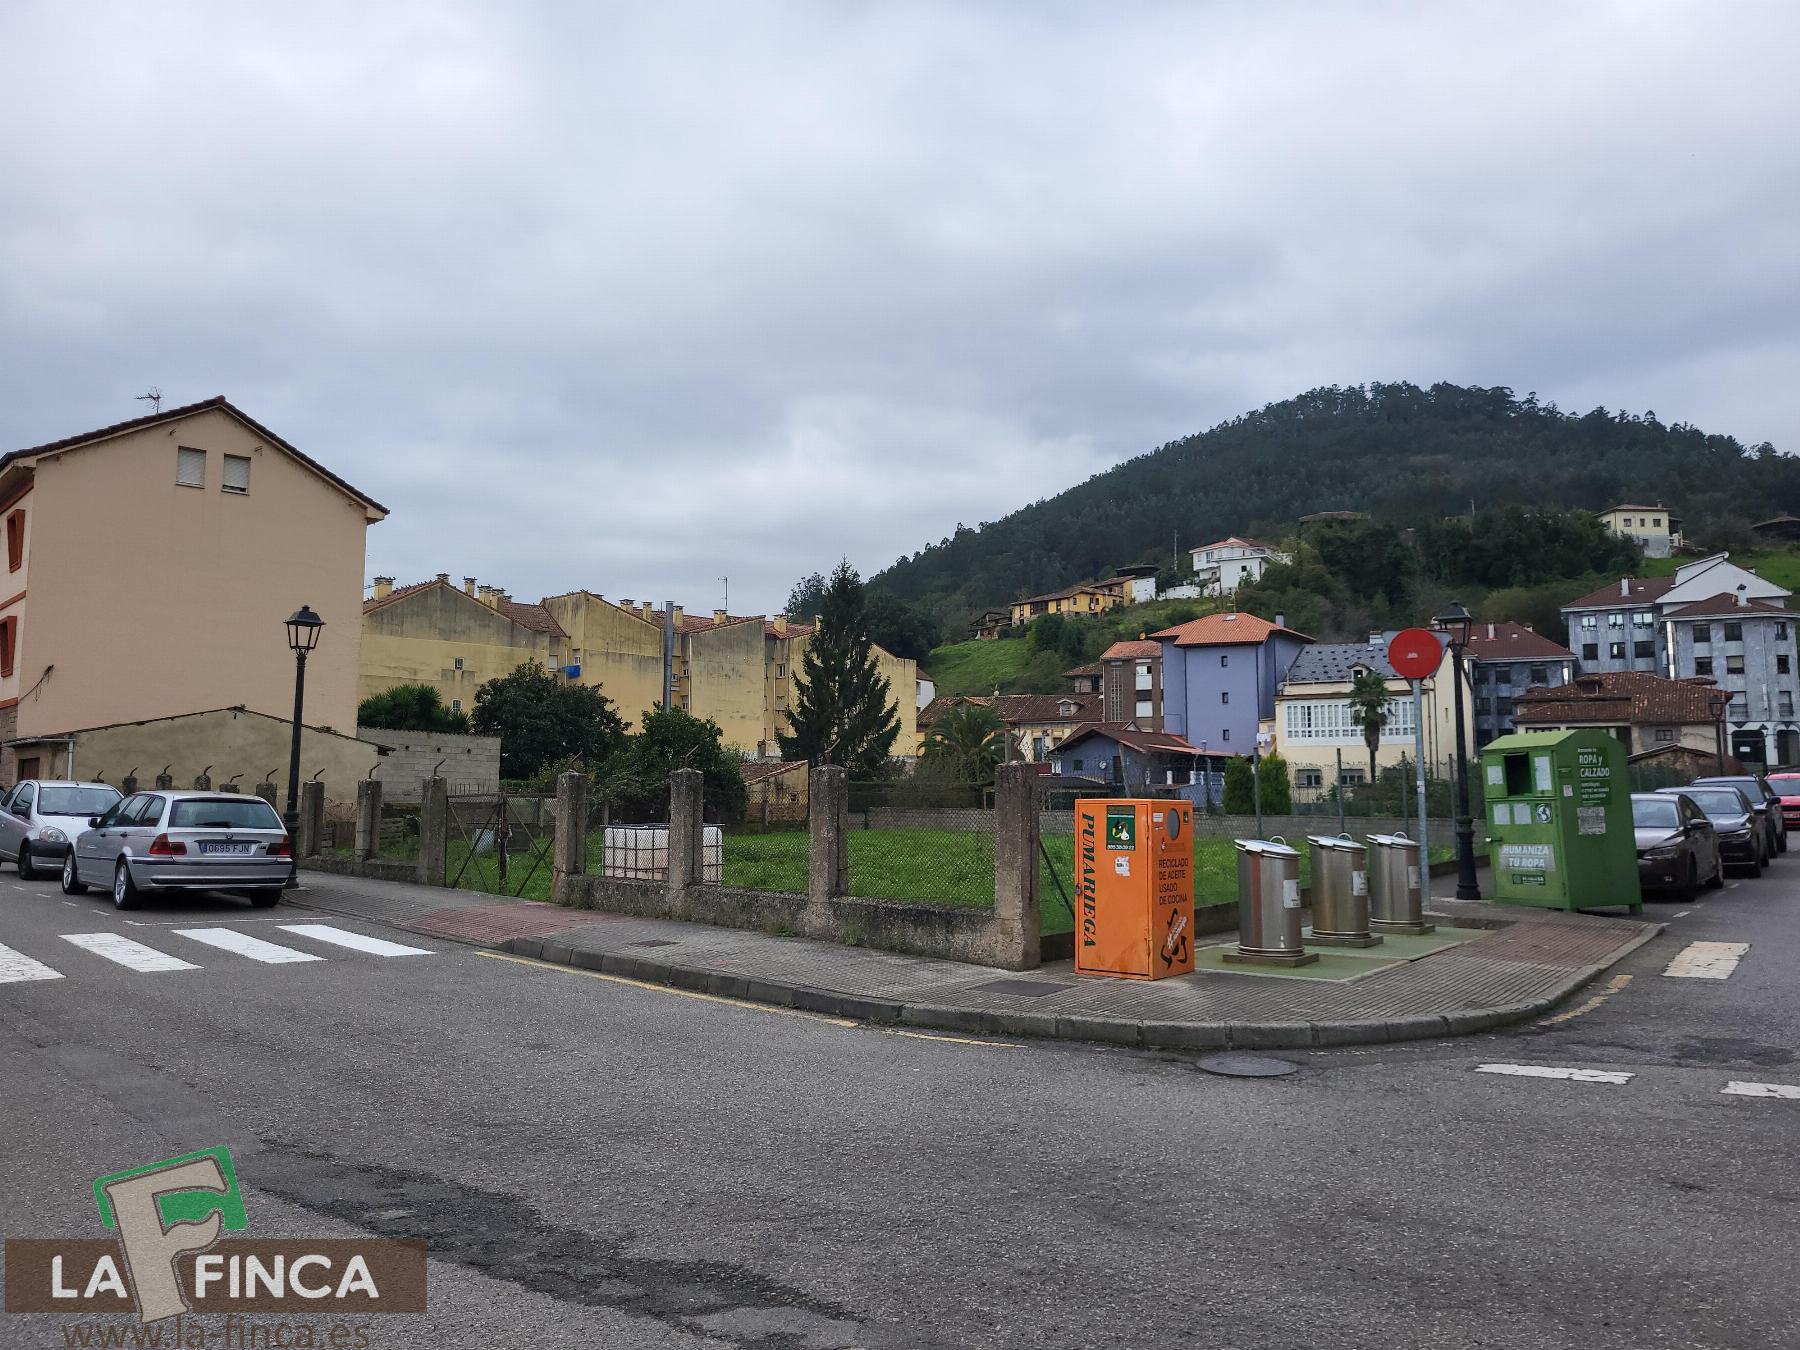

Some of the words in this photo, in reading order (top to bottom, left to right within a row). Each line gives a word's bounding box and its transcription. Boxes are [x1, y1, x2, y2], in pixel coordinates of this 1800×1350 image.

[1579, 754, 1598, 765] ROPA
[1580, 767, 1610, 778] CALZADO
[208, 844, 231, 853] 0695
[232, 844, 250, 853] FJN
[1503, 845, 1550, 855] HUMANIZA
[1158, 857, 1189, 868] RECICLADO
[1509, 857, 1520, 867] TU
[1521, 858, 1545, 868] ROPA
[1082, 812, 1096, 947] PUMARIEGA
[1159, 870, 1167, 880] DE
[1168, 869, 1186, 880] ACEITE
[1159, 882, 1178, 893] USADO
[1159, 895, 1167, 906] DE
[1168, 893, 1188, 905] COCINA
